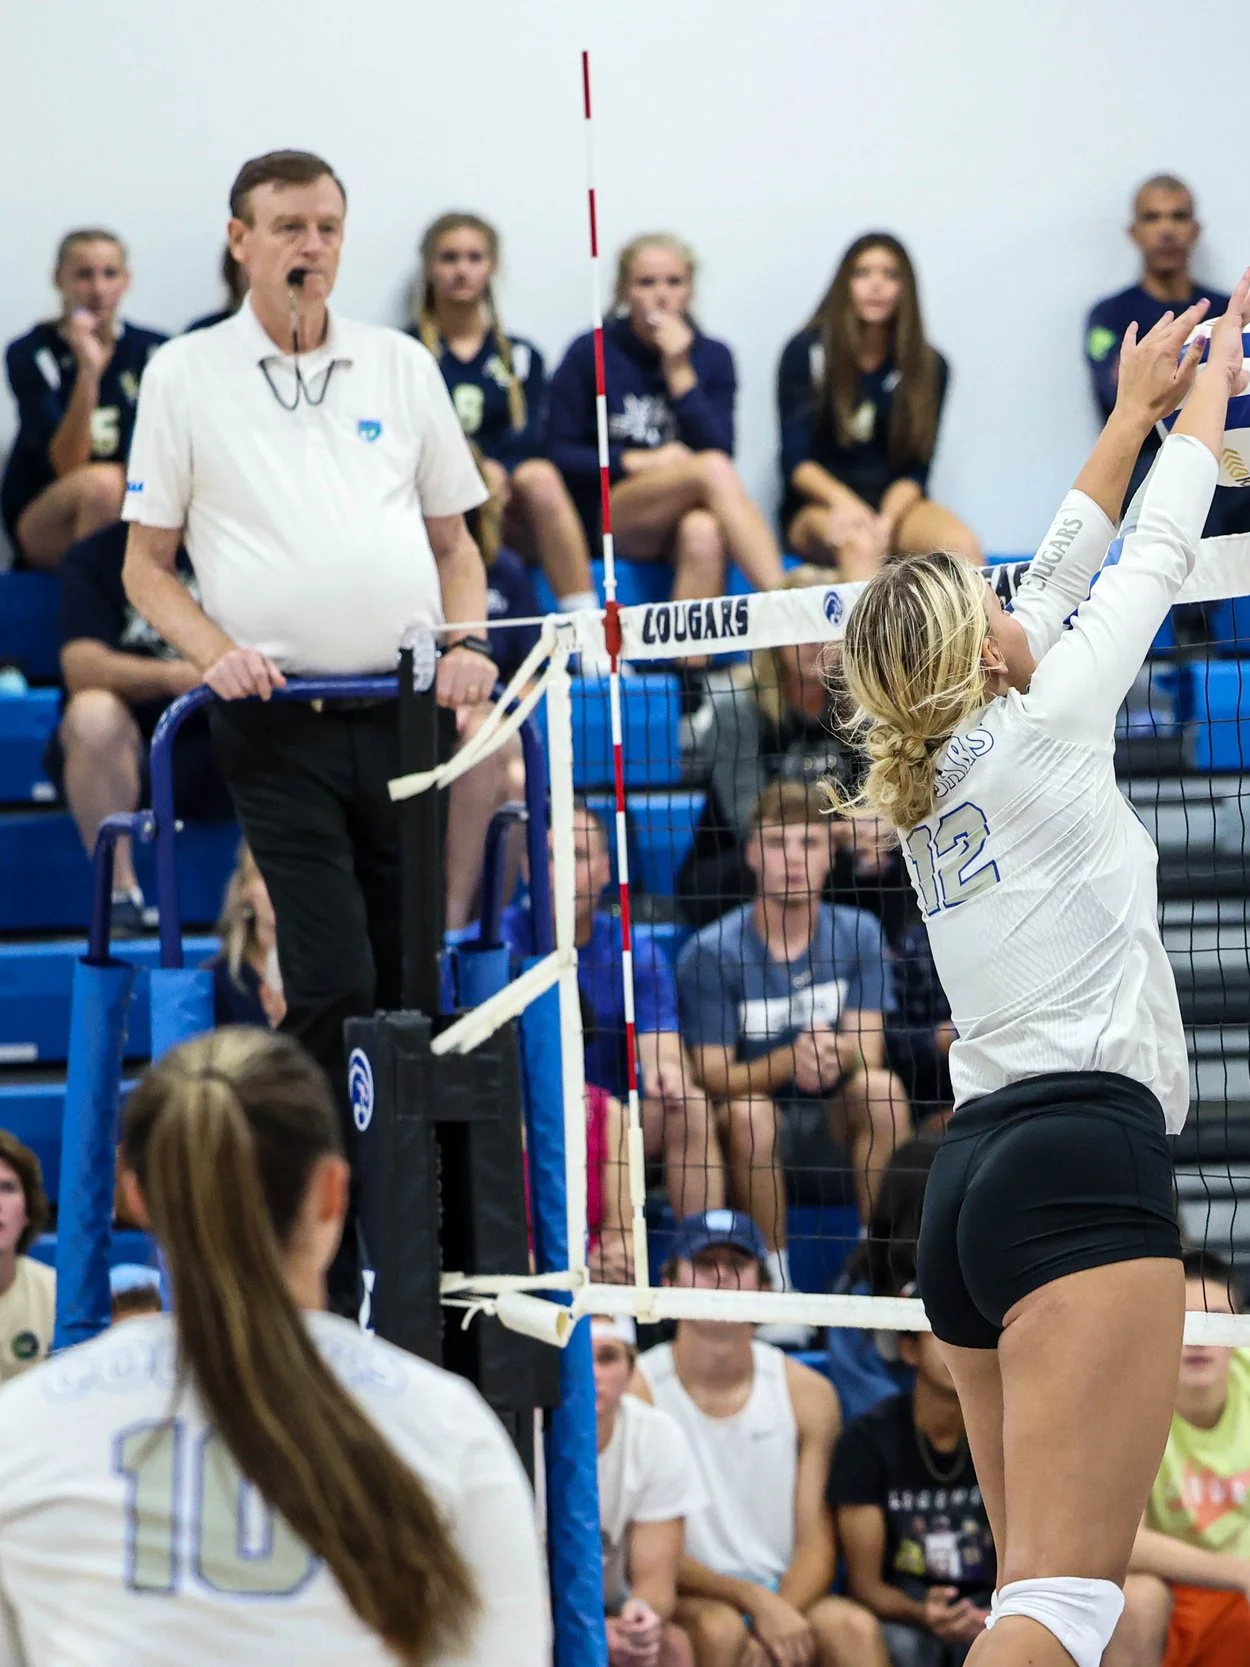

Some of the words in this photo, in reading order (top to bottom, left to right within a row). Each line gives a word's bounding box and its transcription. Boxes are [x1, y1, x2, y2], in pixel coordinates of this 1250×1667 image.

[642, 598, 749, 645] COUGARS
[906, 801, 1001, 917] 12
[111, 1415, 325, 1597] 10
